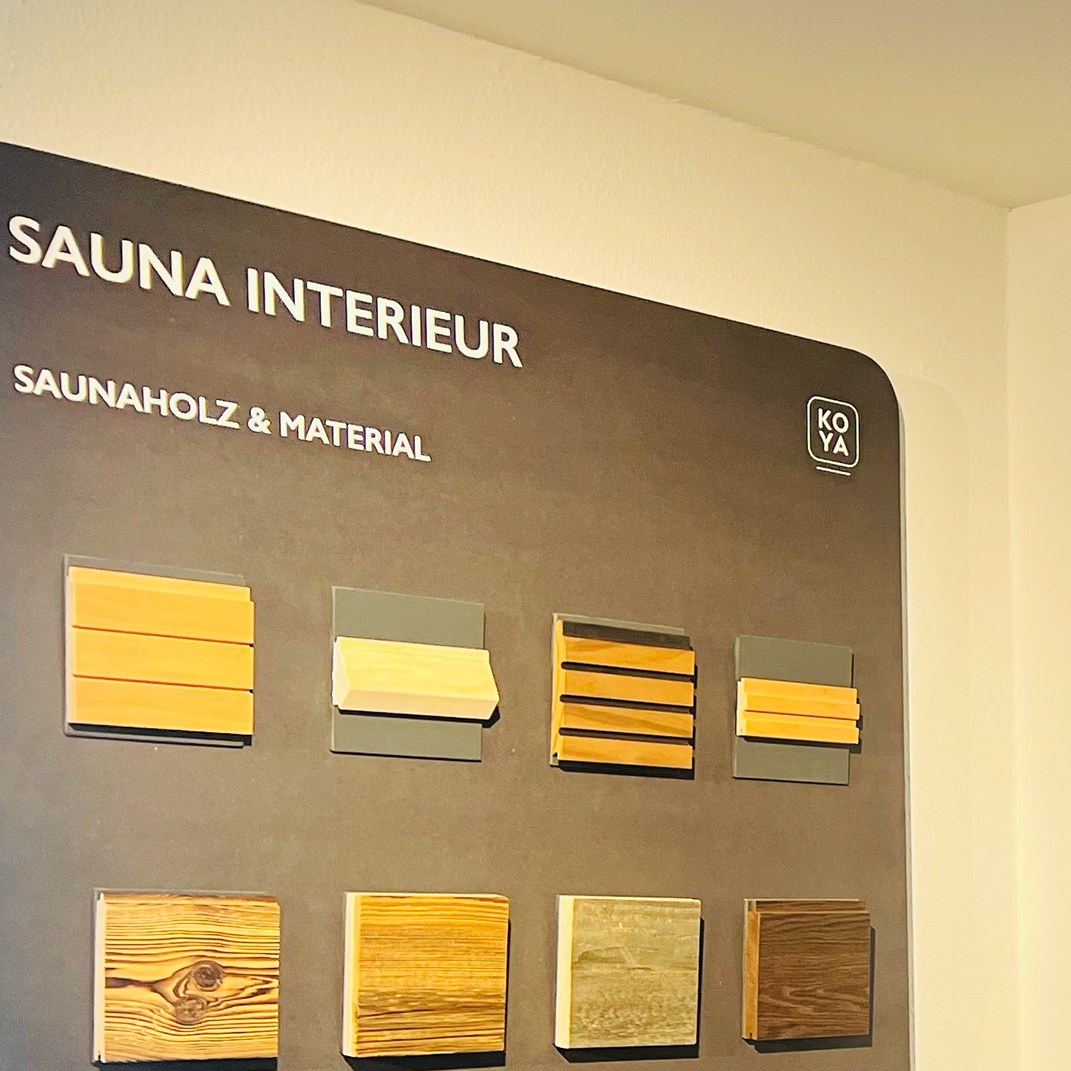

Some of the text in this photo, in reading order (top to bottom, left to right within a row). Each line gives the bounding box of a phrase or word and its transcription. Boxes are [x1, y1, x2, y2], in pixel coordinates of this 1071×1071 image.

[9, 215, 523, 368] SAUNA INTERIEUR
[14, 364, 432, 462] SAUNAHOLZ & MATERIAL
[818, 407, 849, 434] KO
[818, 430, 849, 457] YA
